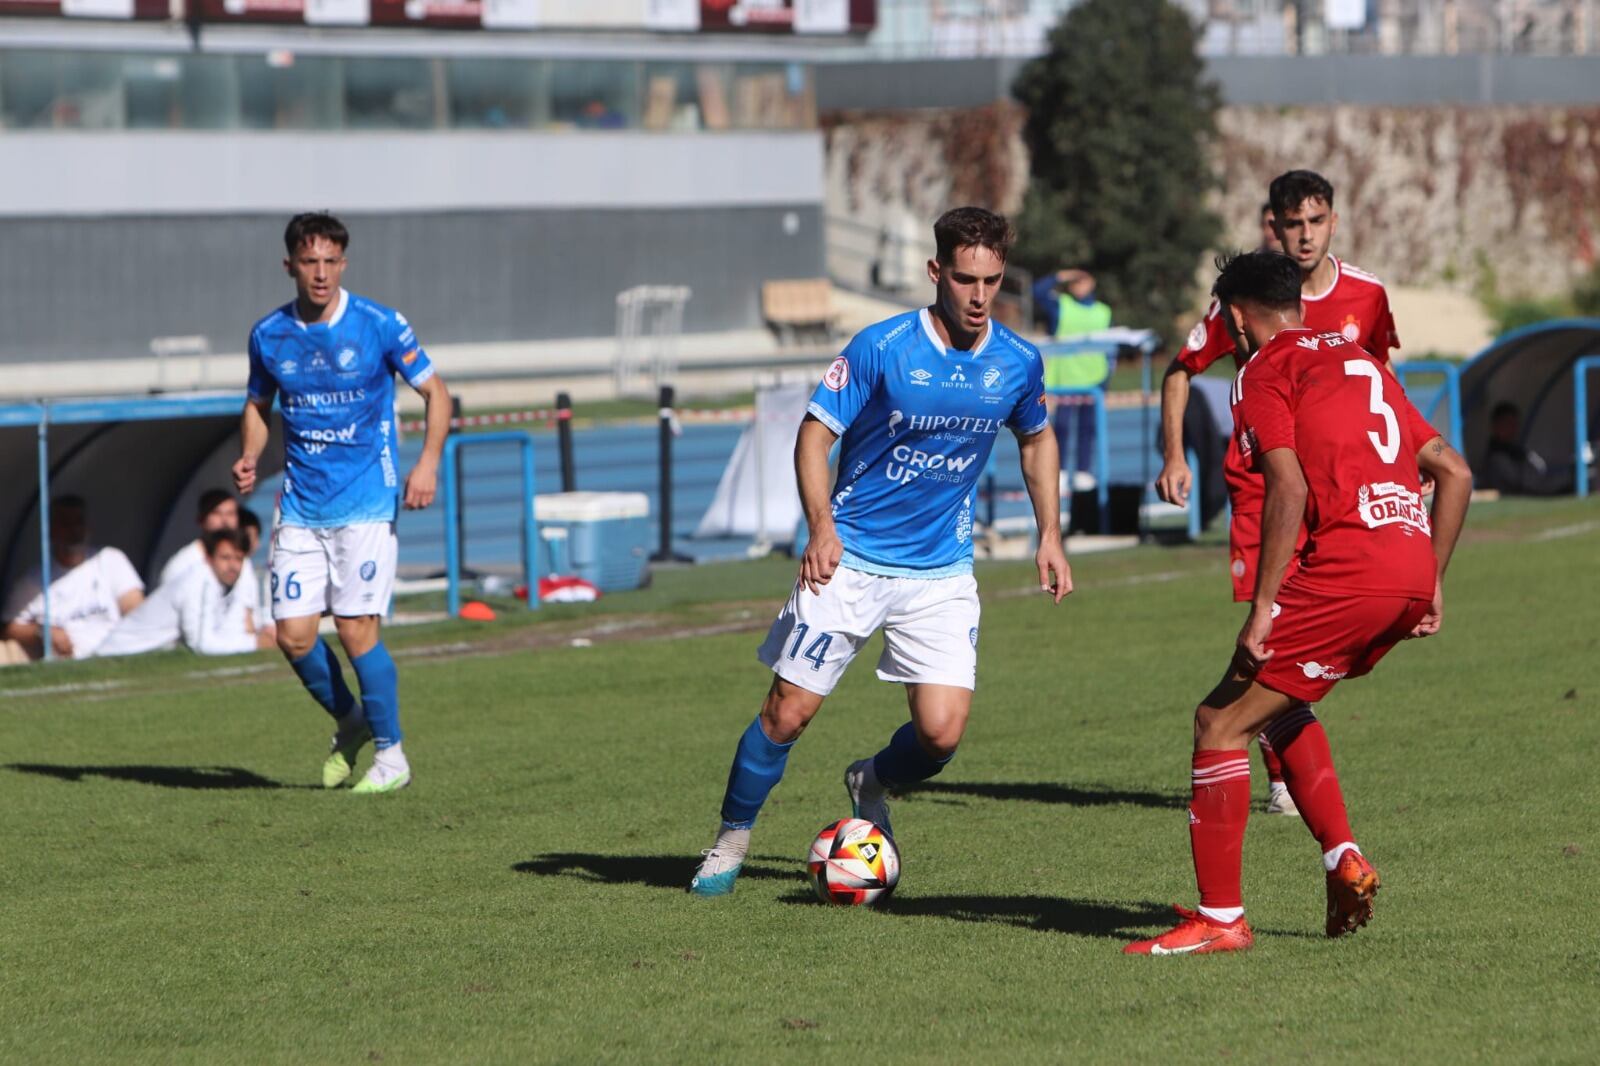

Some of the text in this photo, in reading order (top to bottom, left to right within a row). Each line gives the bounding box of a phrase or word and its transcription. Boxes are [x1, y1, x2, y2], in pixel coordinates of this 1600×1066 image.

[297, 388, 366, 408] HIPOTELS
[1343, 358, 1401, 464] 3
[908, 414, 1004, 434] HIPOTELS
[892, 444, 977, 473] GROW
[885, 461, 919, 486] UP
[922, 469, 965, 484] Capital
[270, 570, 302, 603] 26
[786, 622, 834, 672] 14
